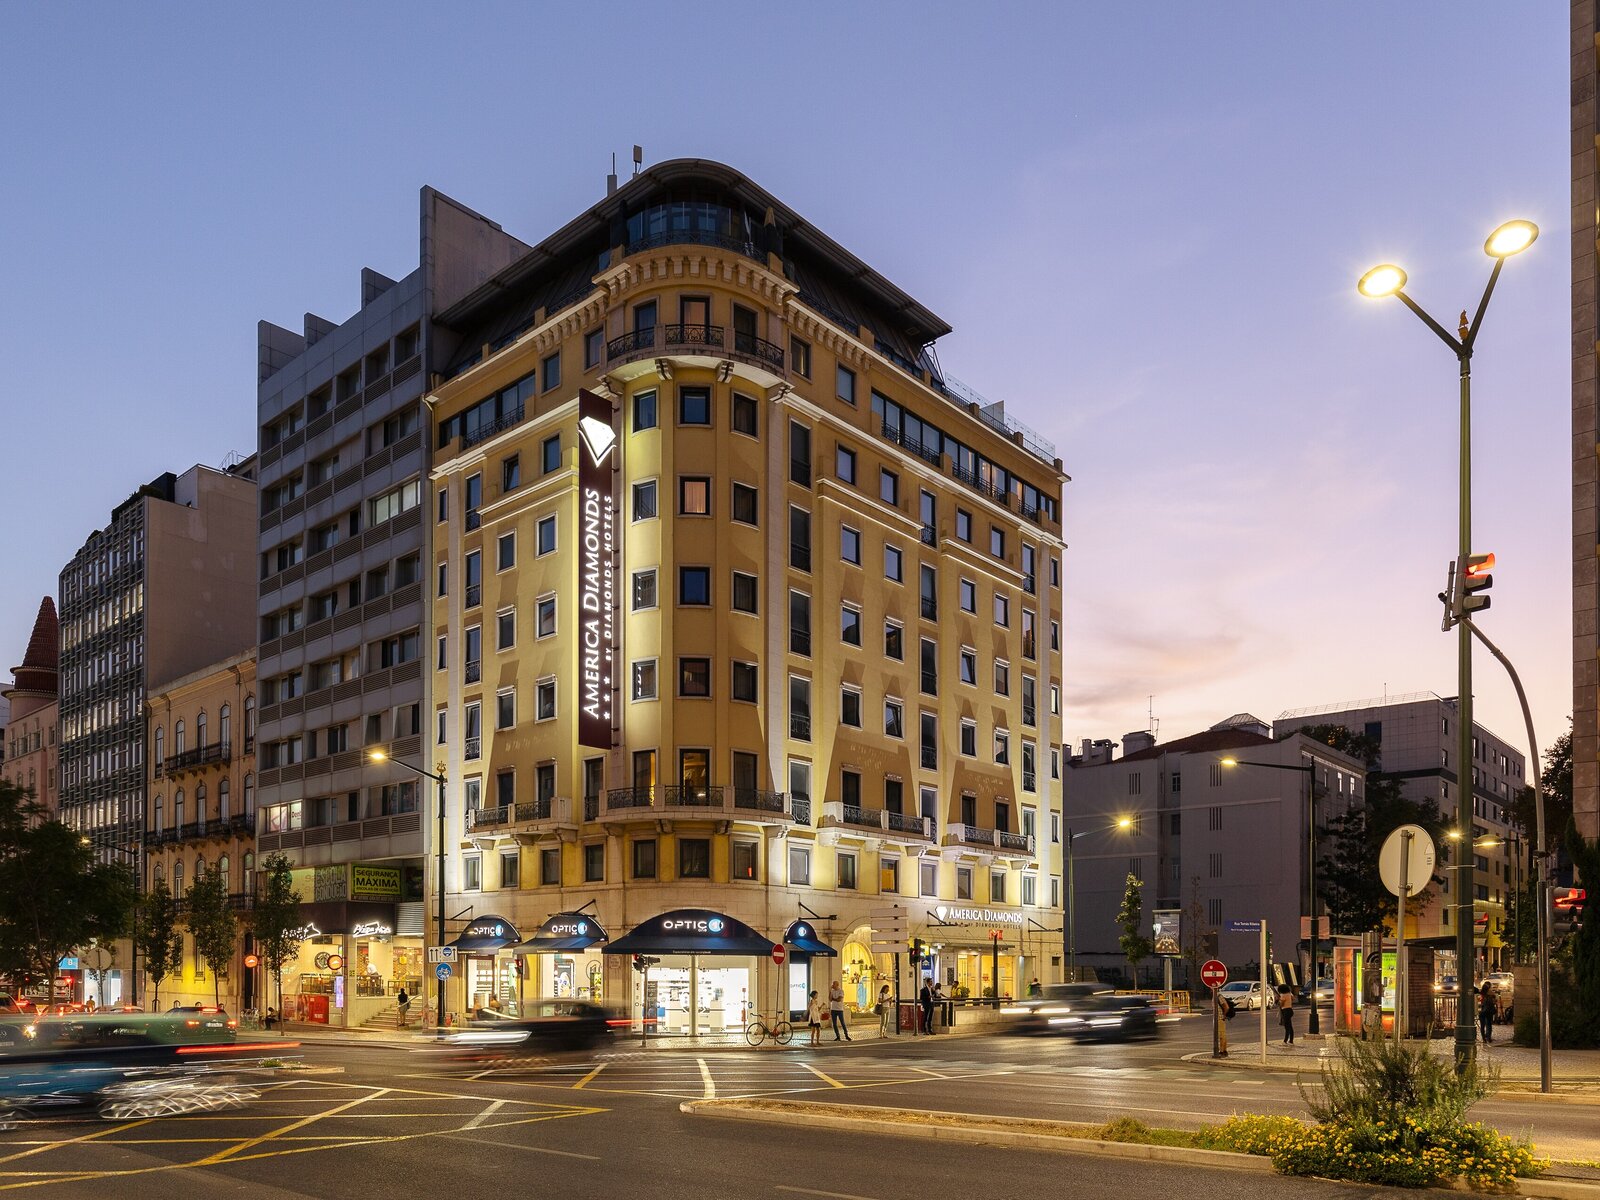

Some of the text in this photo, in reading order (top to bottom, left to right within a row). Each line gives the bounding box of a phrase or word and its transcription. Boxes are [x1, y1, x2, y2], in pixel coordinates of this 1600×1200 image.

[604, 495, 612, 552] HOTELS
[583, 488, 600, 720] AMERICA DIAMONDS
[604, 561, 612, 640] DIAMONDS
[356, 869, 398, 879] SEGURANÇA
[356, 877, 398, 888] MÁXIMA
[949, 907, 1023, 923] AMERICA DIAMONDS
